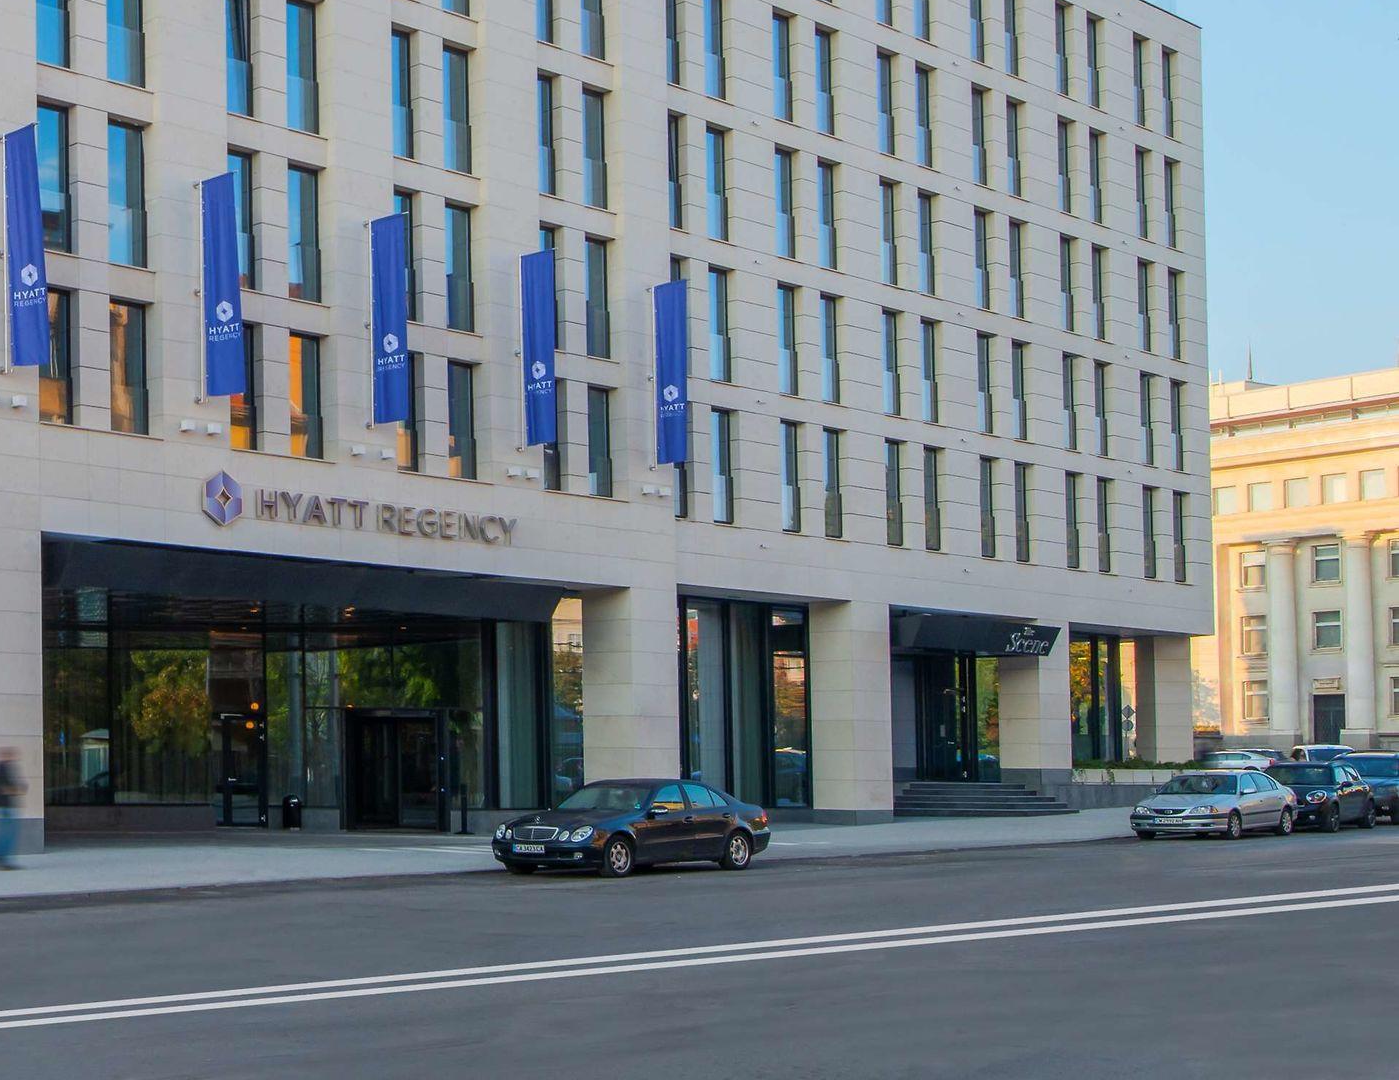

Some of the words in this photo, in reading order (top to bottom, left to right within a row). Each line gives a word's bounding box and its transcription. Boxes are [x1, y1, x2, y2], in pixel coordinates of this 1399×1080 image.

[13, 287, 46, 300] HYATT
[13, 297, 47, 307] REGENCY
[209, 322, 240, 335] HYATT
[209, 332, 241, 342] REGENCY
[377, 354, 405, 365] HYATT
[255, 488, 369, 529] HYATT
[376, 503, 518, 545] REGENCY
[1005, 632, 1050, 655] Scene
